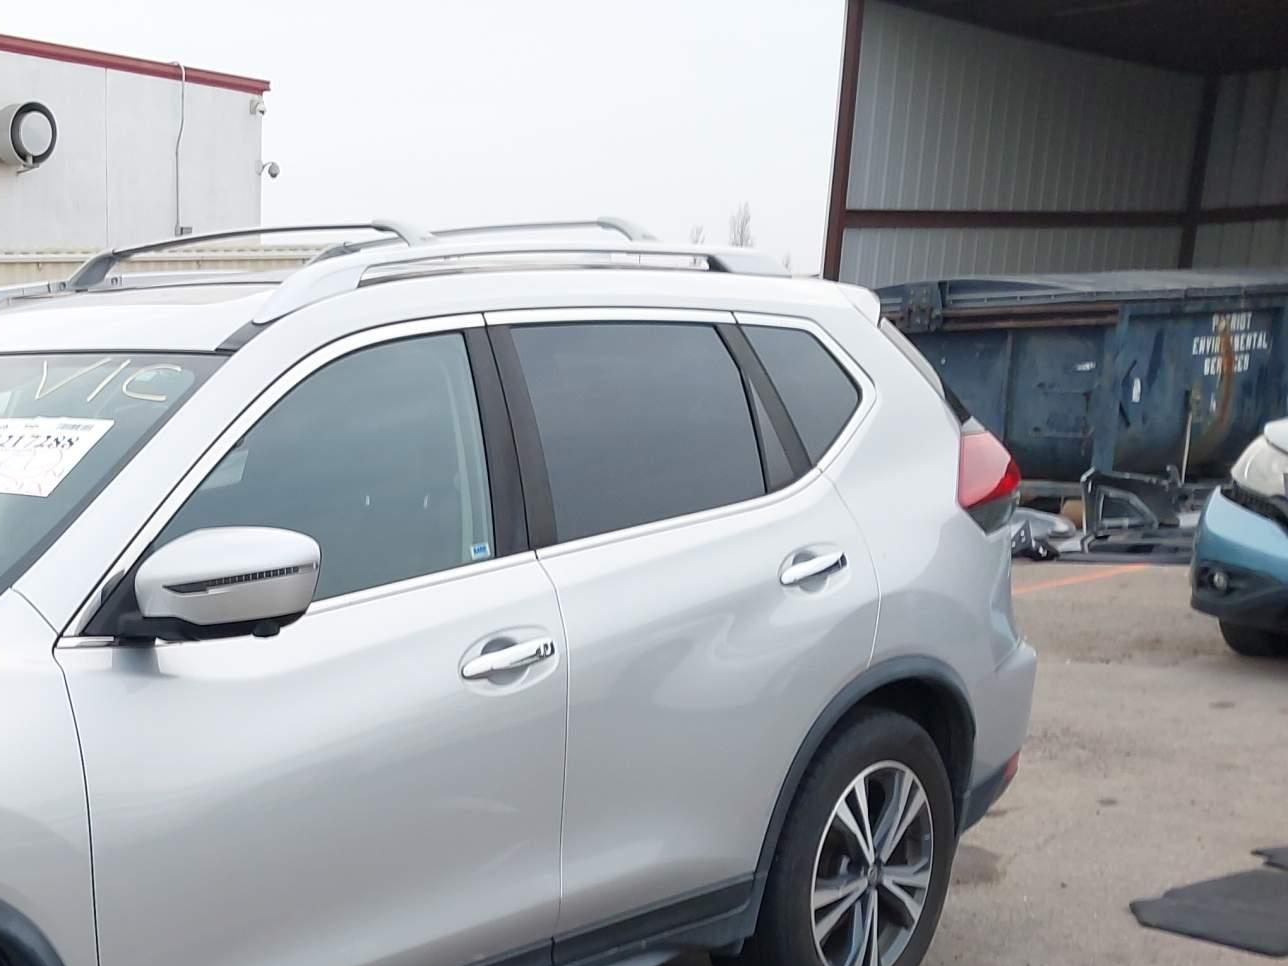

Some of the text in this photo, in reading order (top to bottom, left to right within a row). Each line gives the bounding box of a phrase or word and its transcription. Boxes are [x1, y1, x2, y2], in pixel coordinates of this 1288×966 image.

[1192, 331, 1268, 355] ENVIRMENTAL
[1203, 354, 1250, 376] SERCES
[35, 357, 182, 402] VIC
